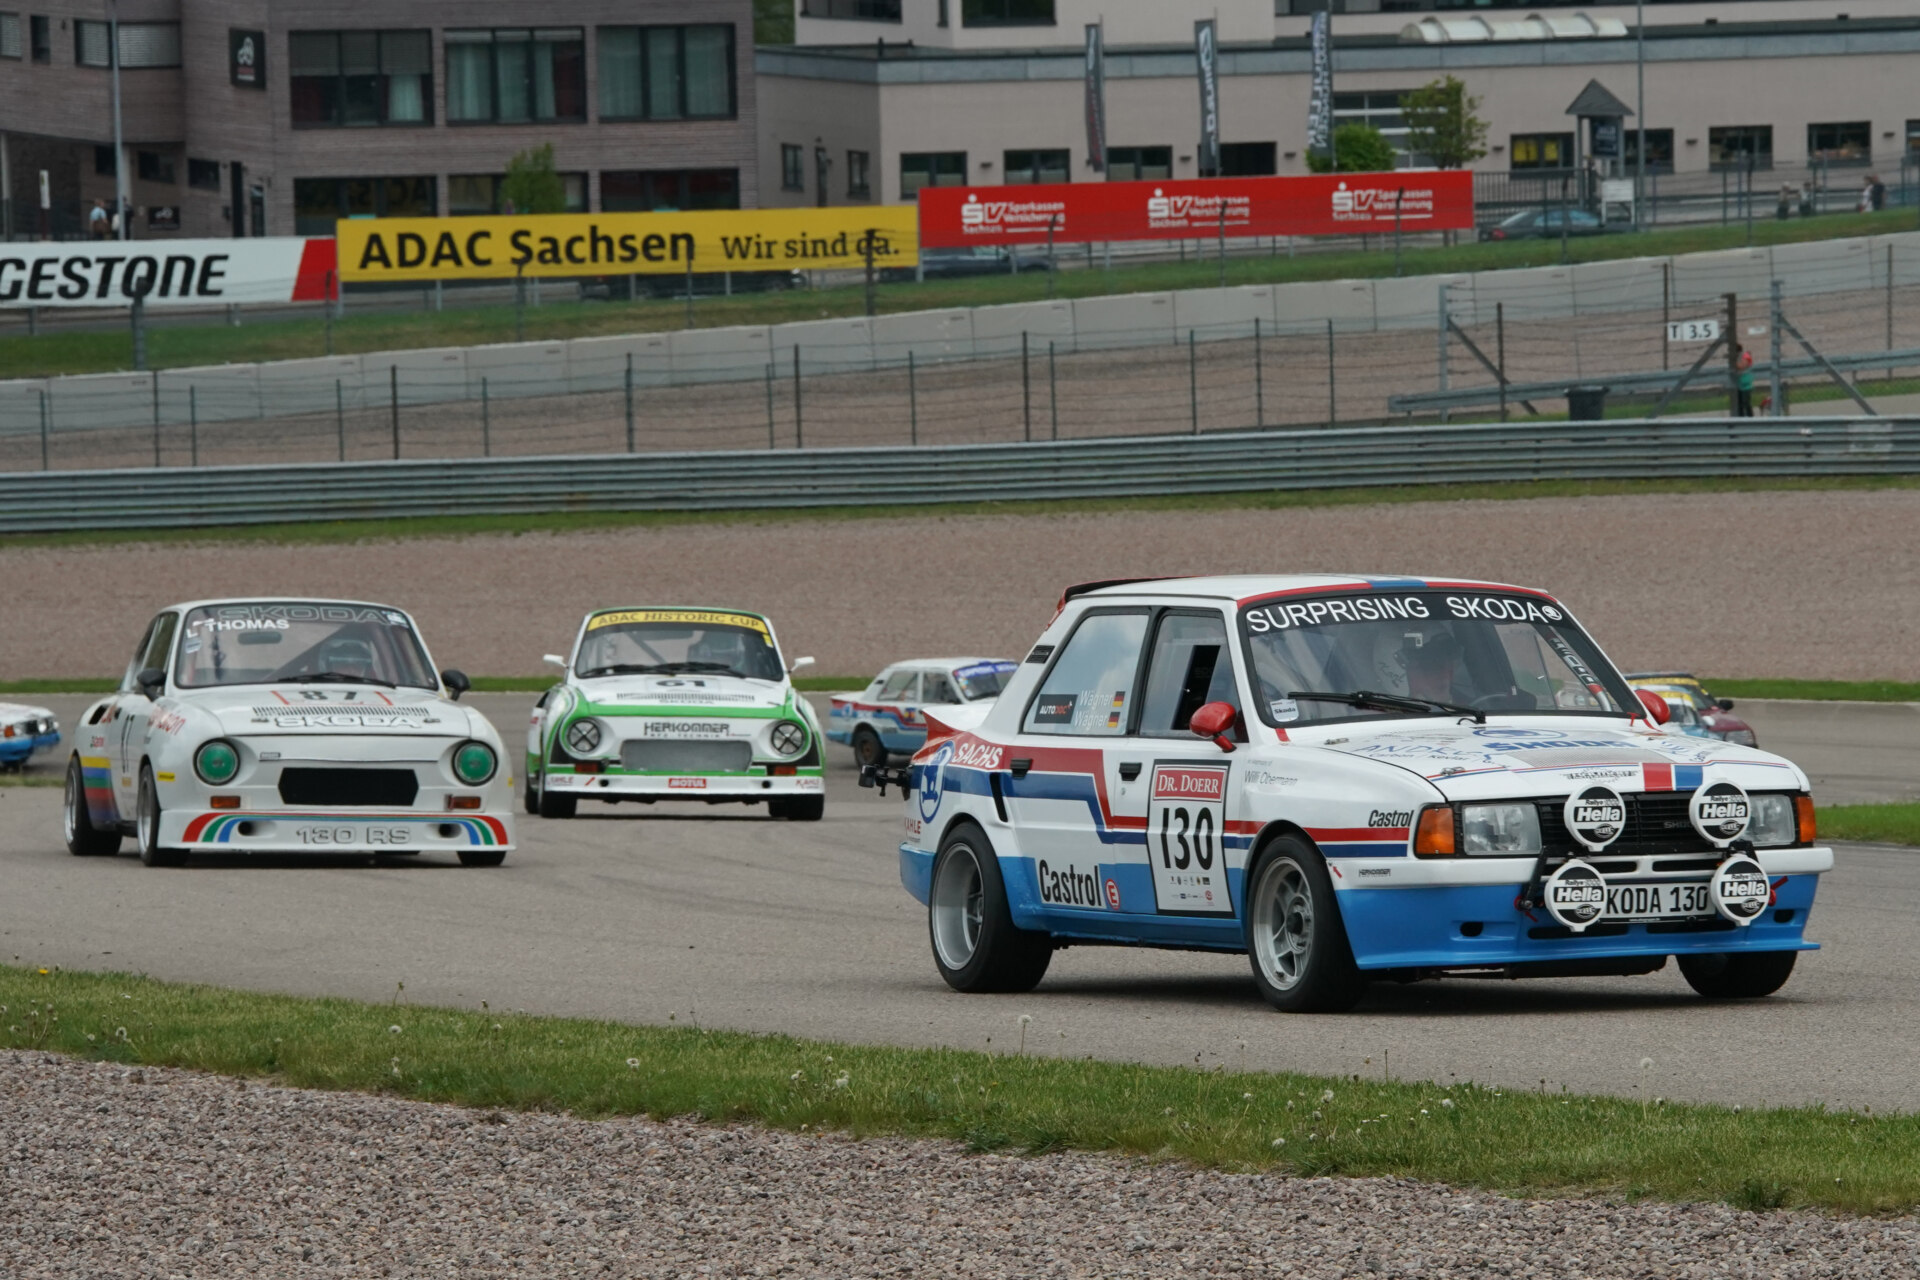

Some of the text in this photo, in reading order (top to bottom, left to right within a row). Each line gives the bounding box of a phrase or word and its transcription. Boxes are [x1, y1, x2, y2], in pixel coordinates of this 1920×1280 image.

[1377, 189, 1433, 200] Sparassen
[1008, 201, 1065, 213] Sparkassen
[1189, 206, 1250, 217] Versichrung
[1373, 200, 1433, 211] Versiherung
[359, 225, 695, 269] ADAC Sachsen
[721, 233, 777, 260] Wir
[784, 231, 849, 259] sind
[0, 255, 229, 300] GESTONE
[1670, 323, 1712, 339] T 3.5
[217, 606, 392, 626] SKODA
[598, 612, 759, 628] ADAC HISTORIC CUP
[1246, 597, 1550, 632] SURPRISING SKODA
[204, 619, 290, 632] THOMAS
[275, 715, 422, 729] SKODA
[644, 721, 730, 736] HERKOMMER
[952, 743, 1003, 769] SACHS
[670, 778, 705, 788] MOTUL
[1368, 809, 1414, 827] Castrol
[1577, 807, 1620, 822] Hella
[1702, 804, 1746, 819] Hella
[297, 826, 411, 844] 130 RS
[1161, 807, 1213, 870] 130
[1039, 859, 1102, 907] Castrol
[1724, 882, 1766, 897] Hella
[1556, 887, 1603, 902] Hella
[1669, 886, 1709, 912] 130
